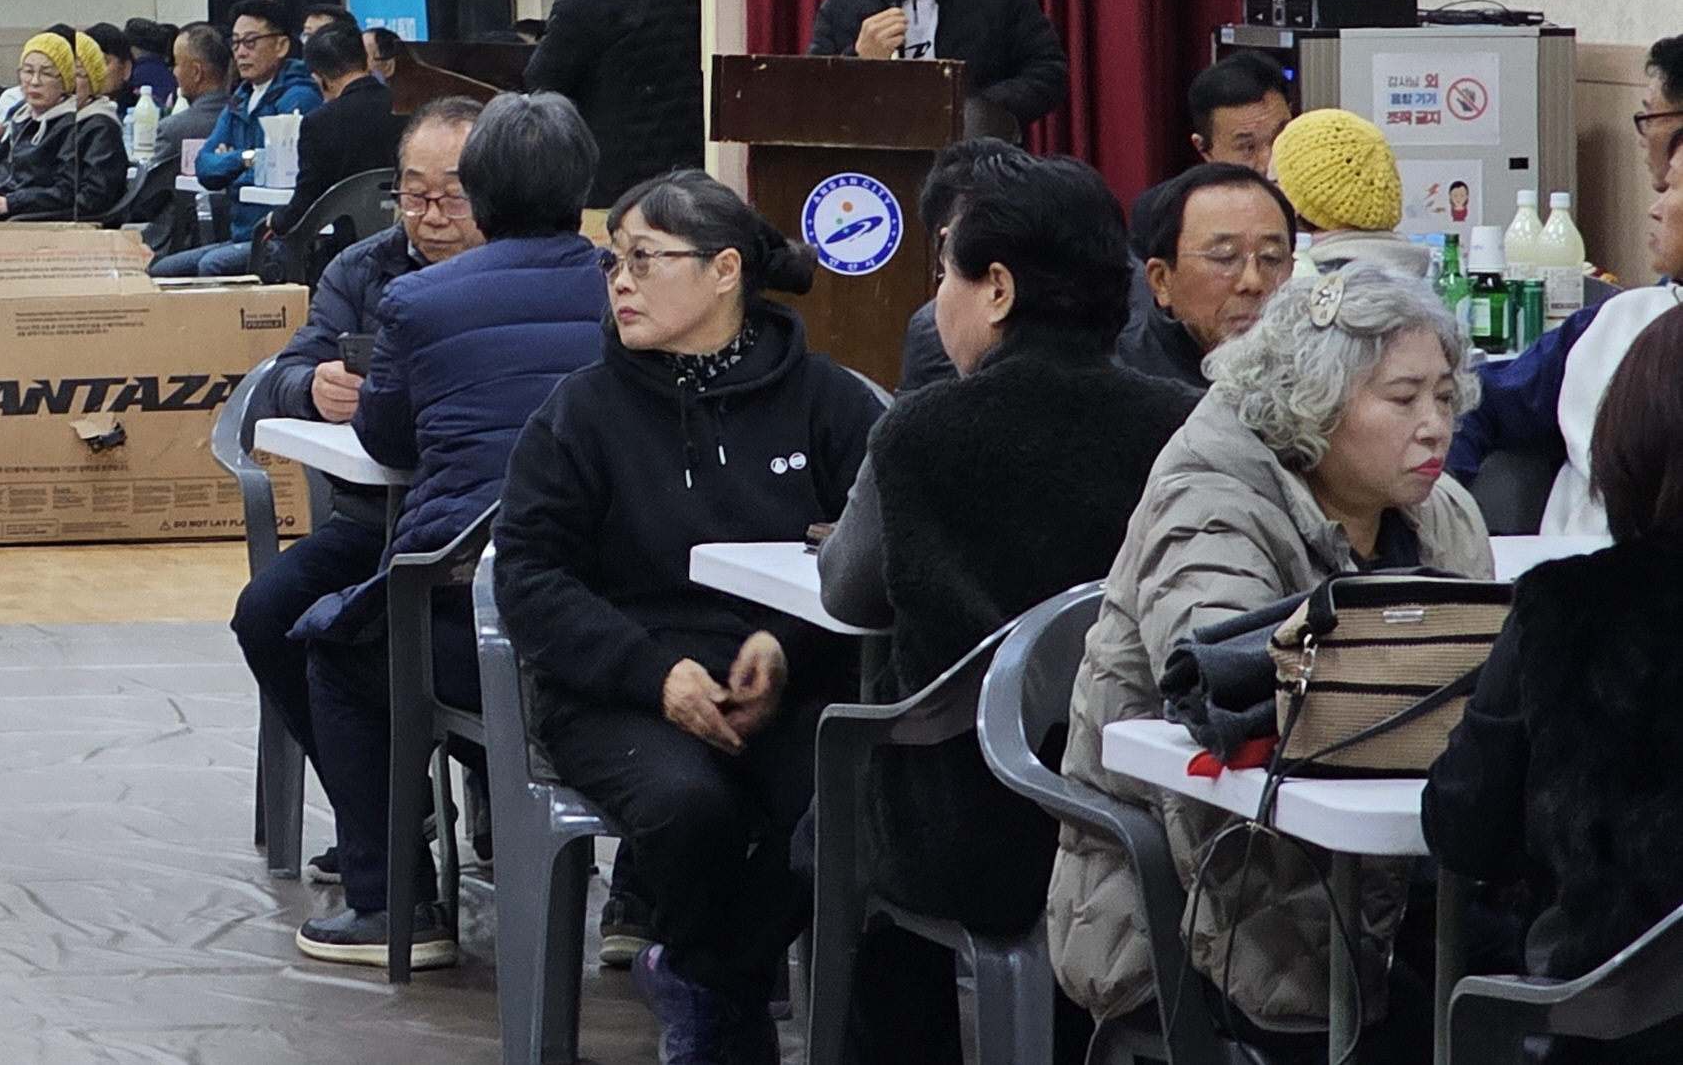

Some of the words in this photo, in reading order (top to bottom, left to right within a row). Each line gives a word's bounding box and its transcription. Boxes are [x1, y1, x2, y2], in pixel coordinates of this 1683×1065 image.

[1424, 73, 1439, 89] 외
[1415, 92, 1437, 105] 기기
[1415, 110, 1442, 125] 금지
[813, 177, 858, 204] ANSAN
[862, 179, 892, 205] CITY
